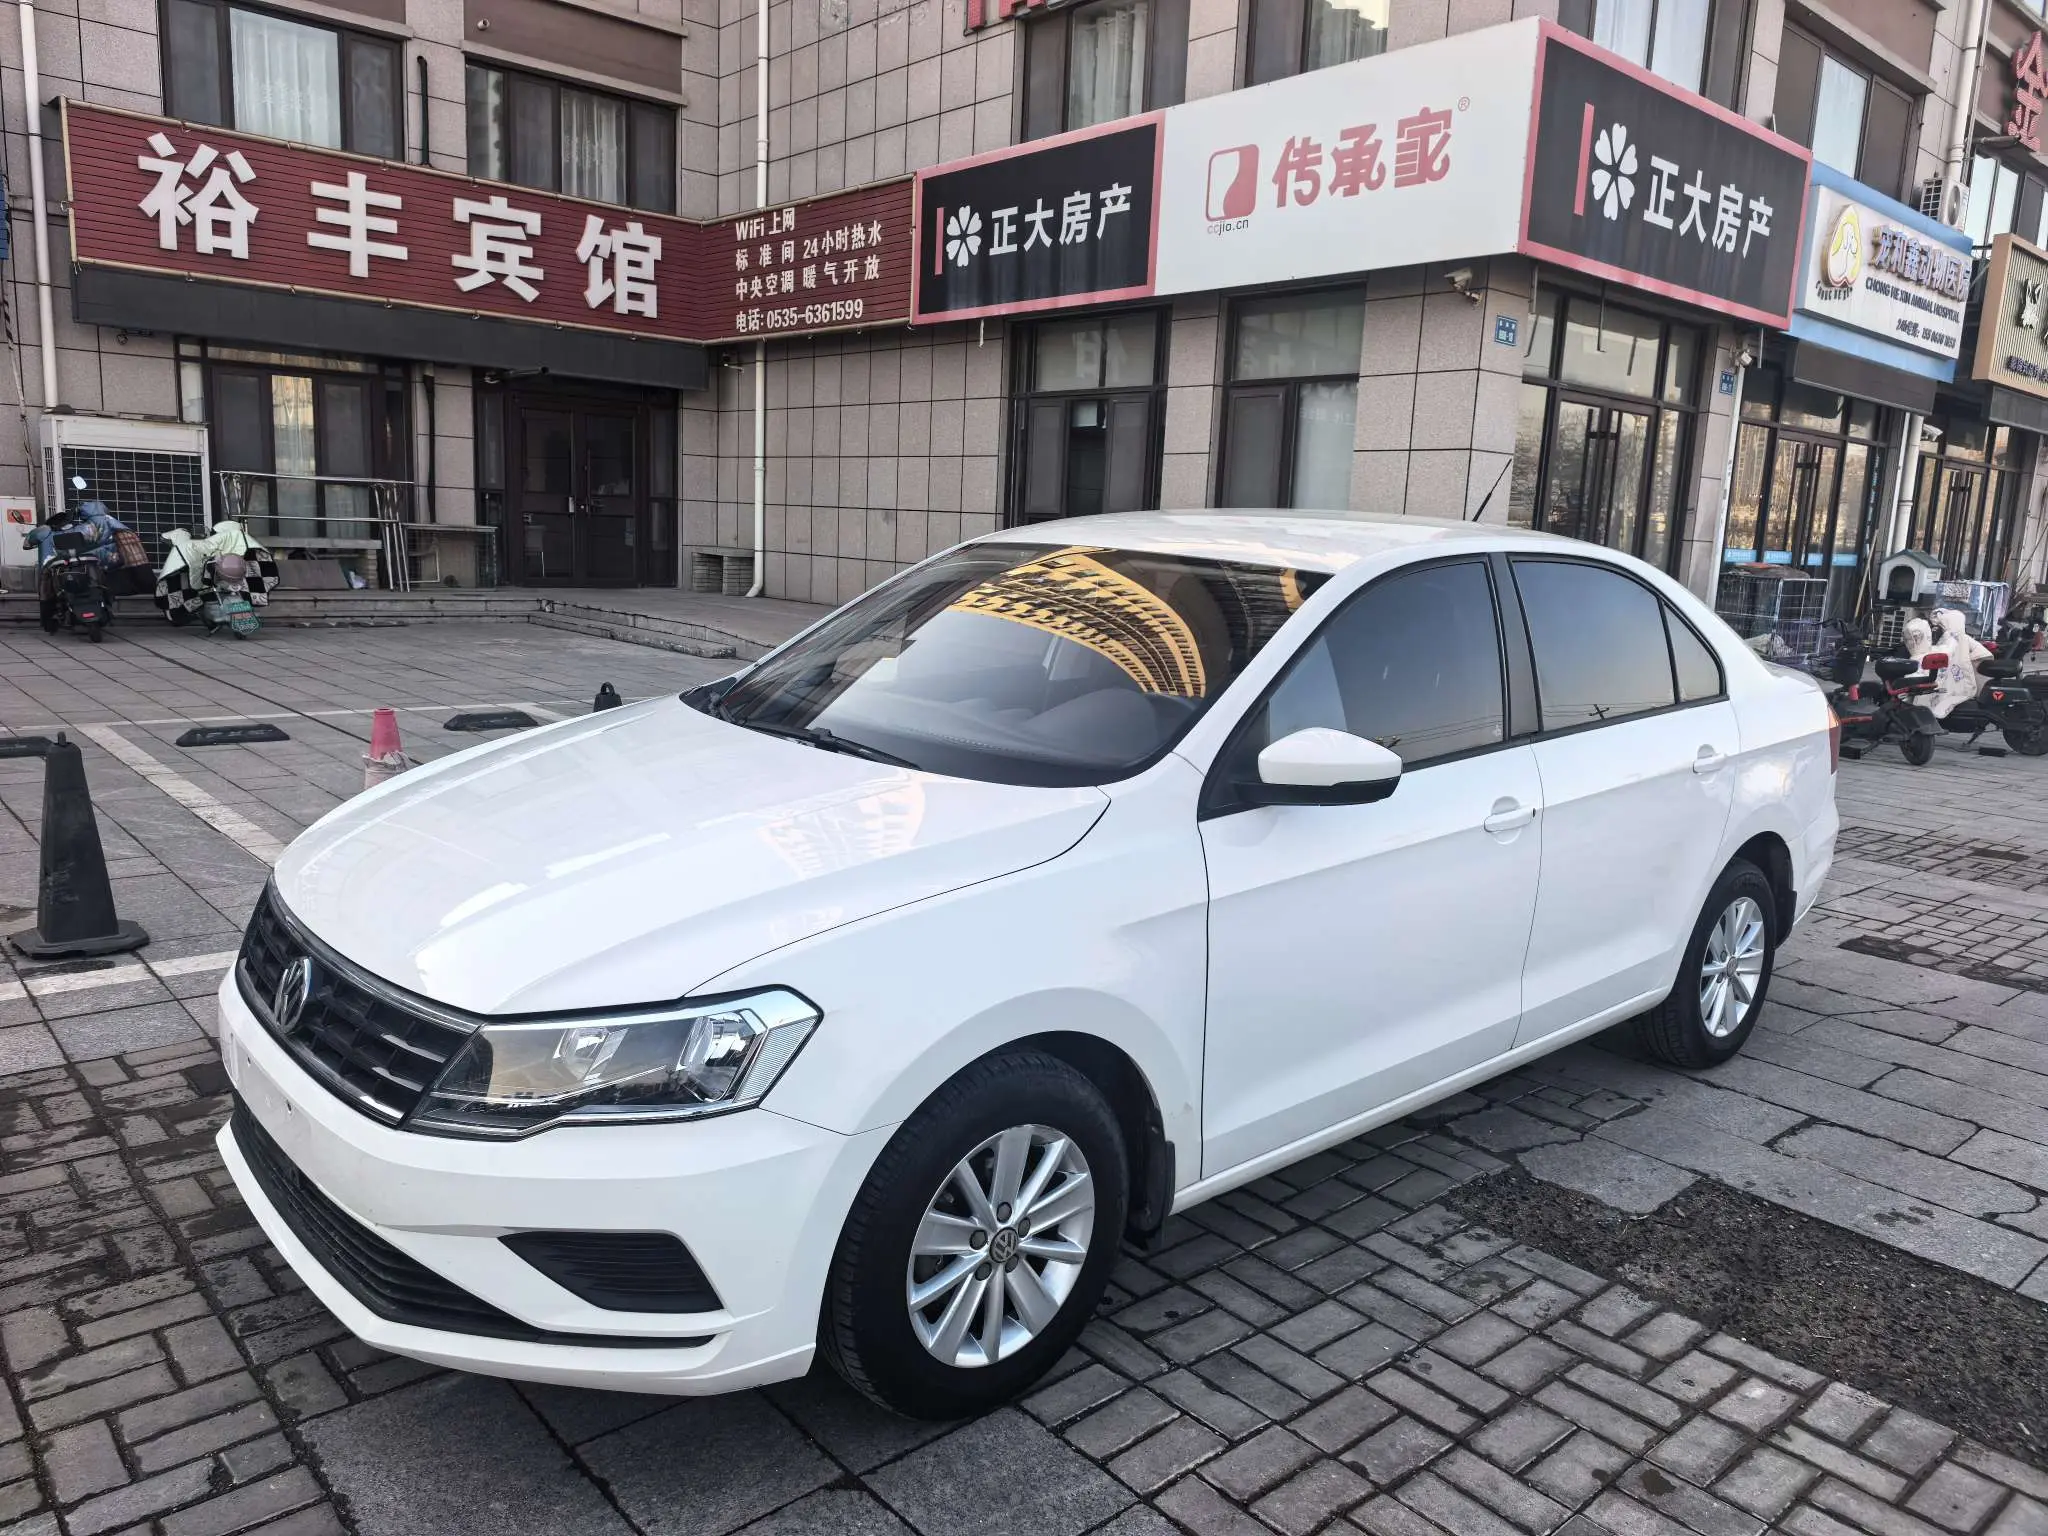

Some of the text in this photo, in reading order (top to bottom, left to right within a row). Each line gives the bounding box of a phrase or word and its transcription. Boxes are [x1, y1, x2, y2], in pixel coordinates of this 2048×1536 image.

[1272, 106, 1452, 208] 传承家
[138, 132, 662, 319] 裕丰宾馆
[735, 207, 795, 241] WiFi 上网
[989, 182, 1132, 257] 正大房产
[1643, 155, 1774, 259] 正大房产
[735, 220, 882, 271] 标准间 24小时热水
[735, 254, 881, 301] 中央空调 暖气开放
